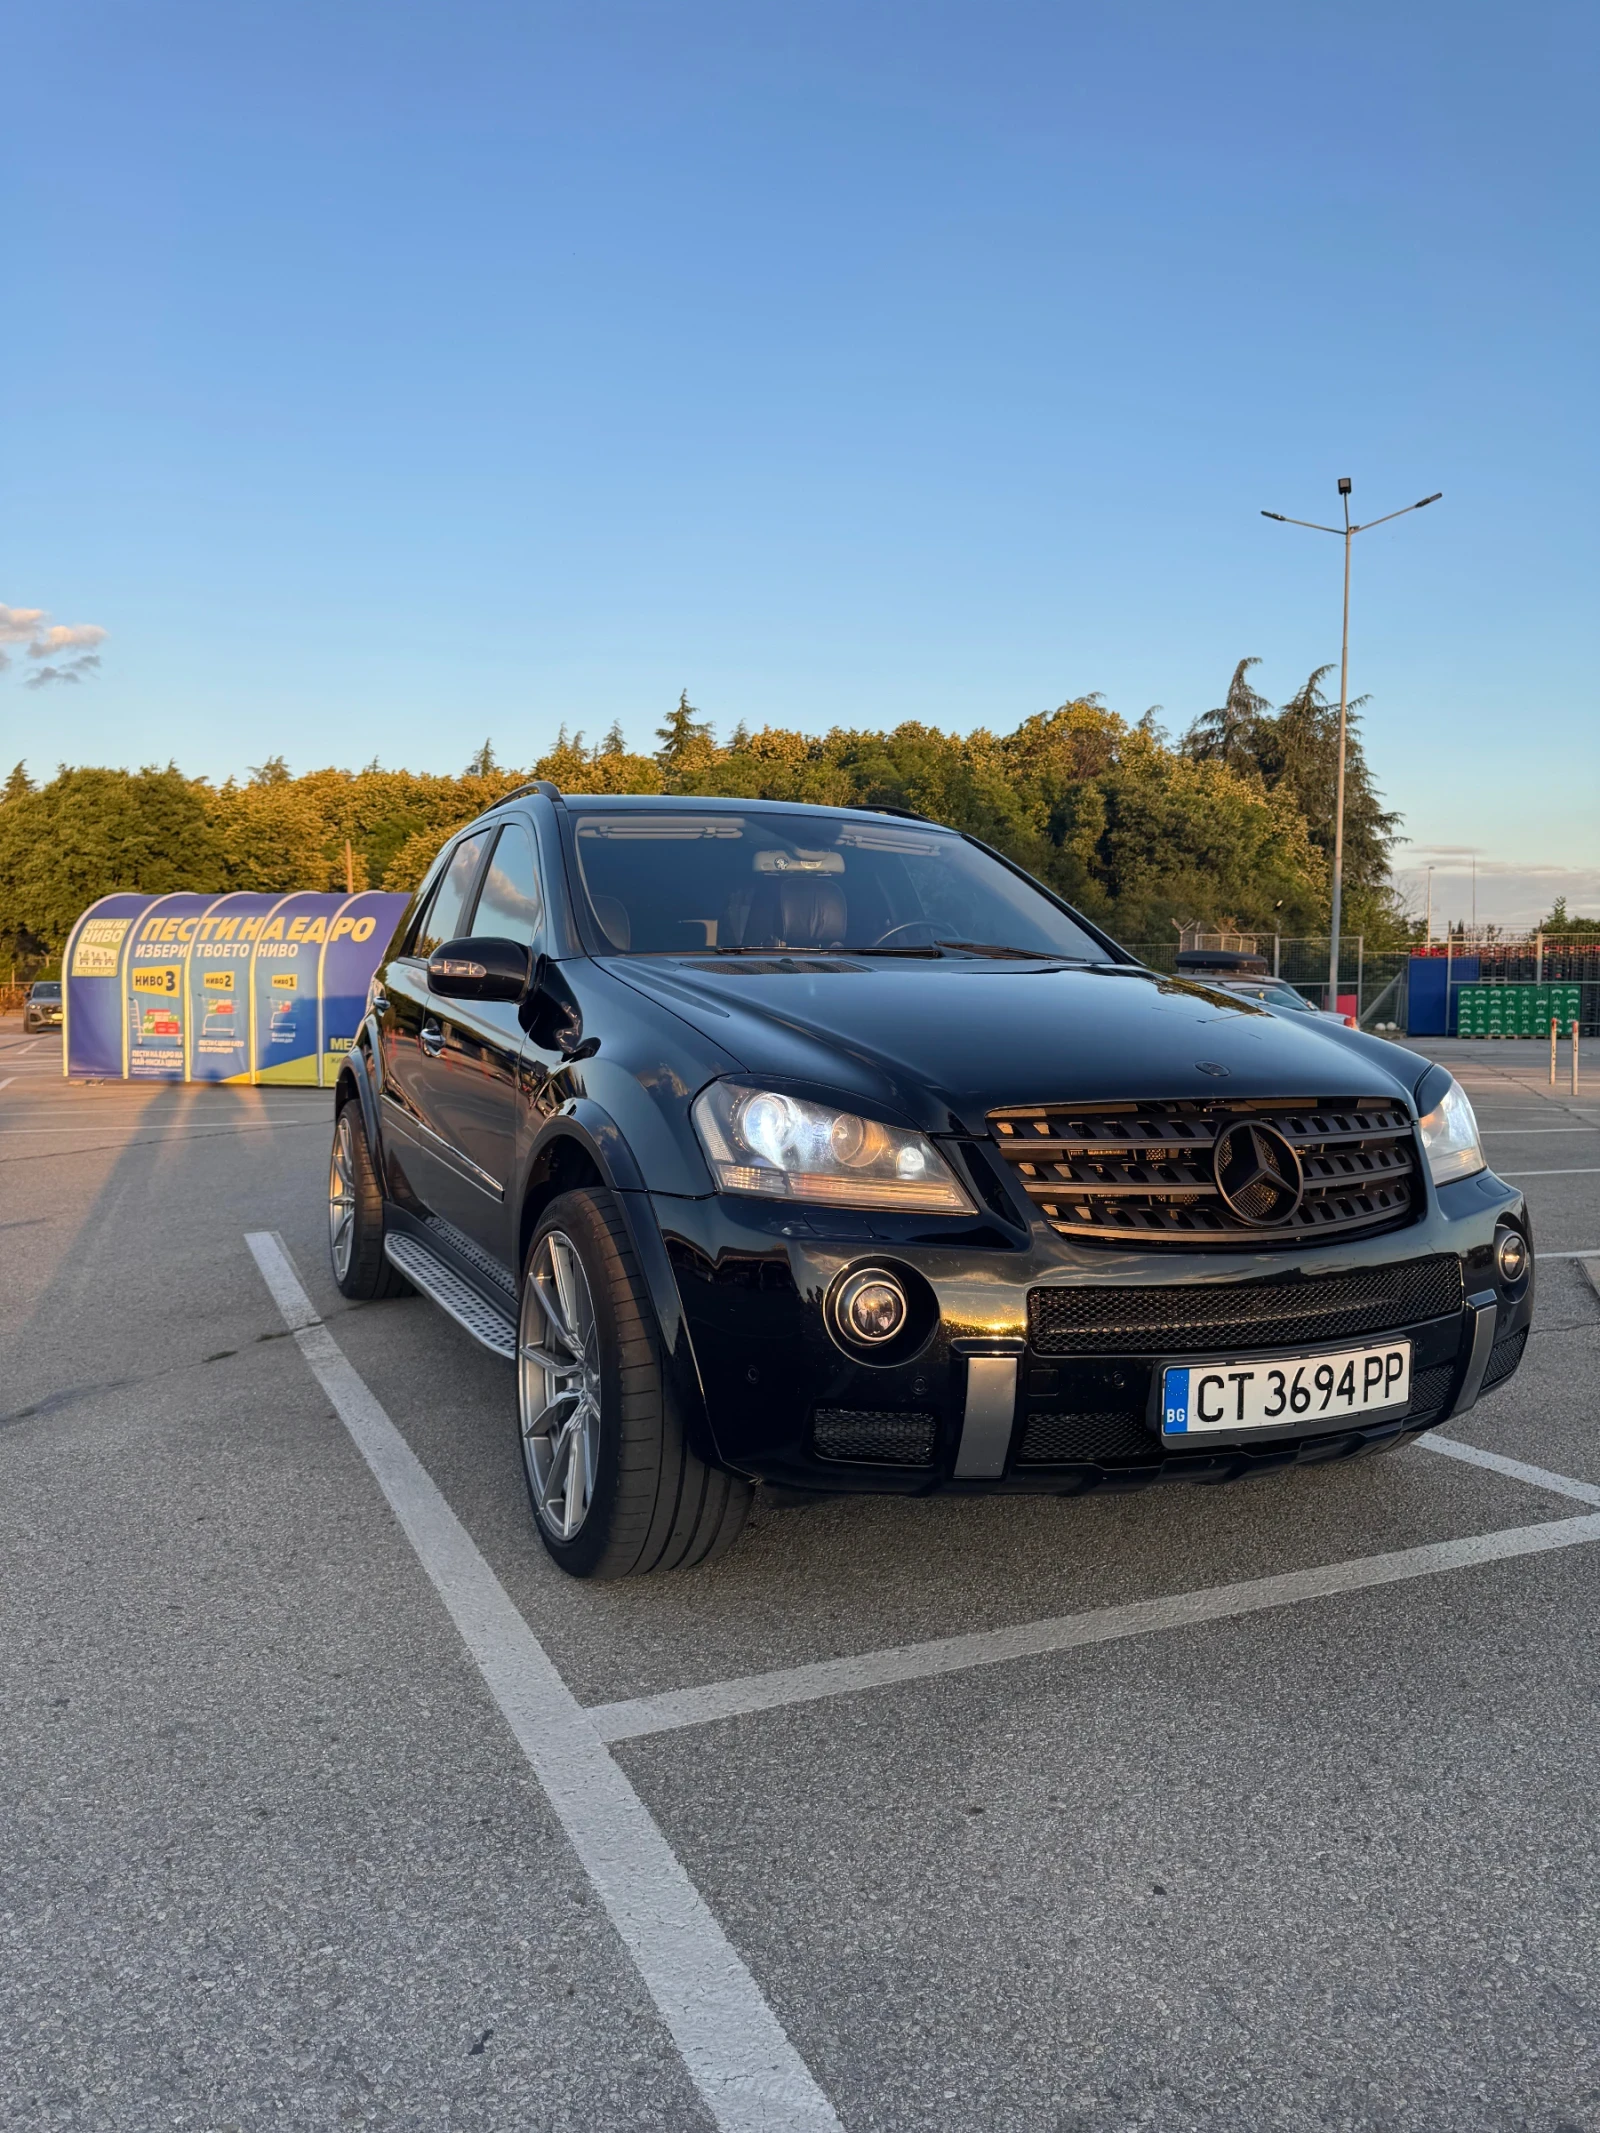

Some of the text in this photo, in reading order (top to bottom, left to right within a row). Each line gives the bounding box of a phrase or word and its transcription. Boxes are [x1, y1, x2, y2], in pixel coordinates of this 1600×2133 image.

[86, 920, 128, 929] ЦЕНИ НА
[139, 916, 377, 944] ПЕСТИ НА ЕДРО
[80, 929, 125, 943] НИВО
[134, 943, 299, 958] ИЗБЕРИ ТВОЕТО НИВО
[135, 970, 176, 992] НИВО 3
[205, 974, 232, 988] НИВО 2
[289, 977, 295, 987] 1
[1197, 1351, 1404, 1423] CT 3694 PP
[1166, 1408, 1185, 1423] BG
